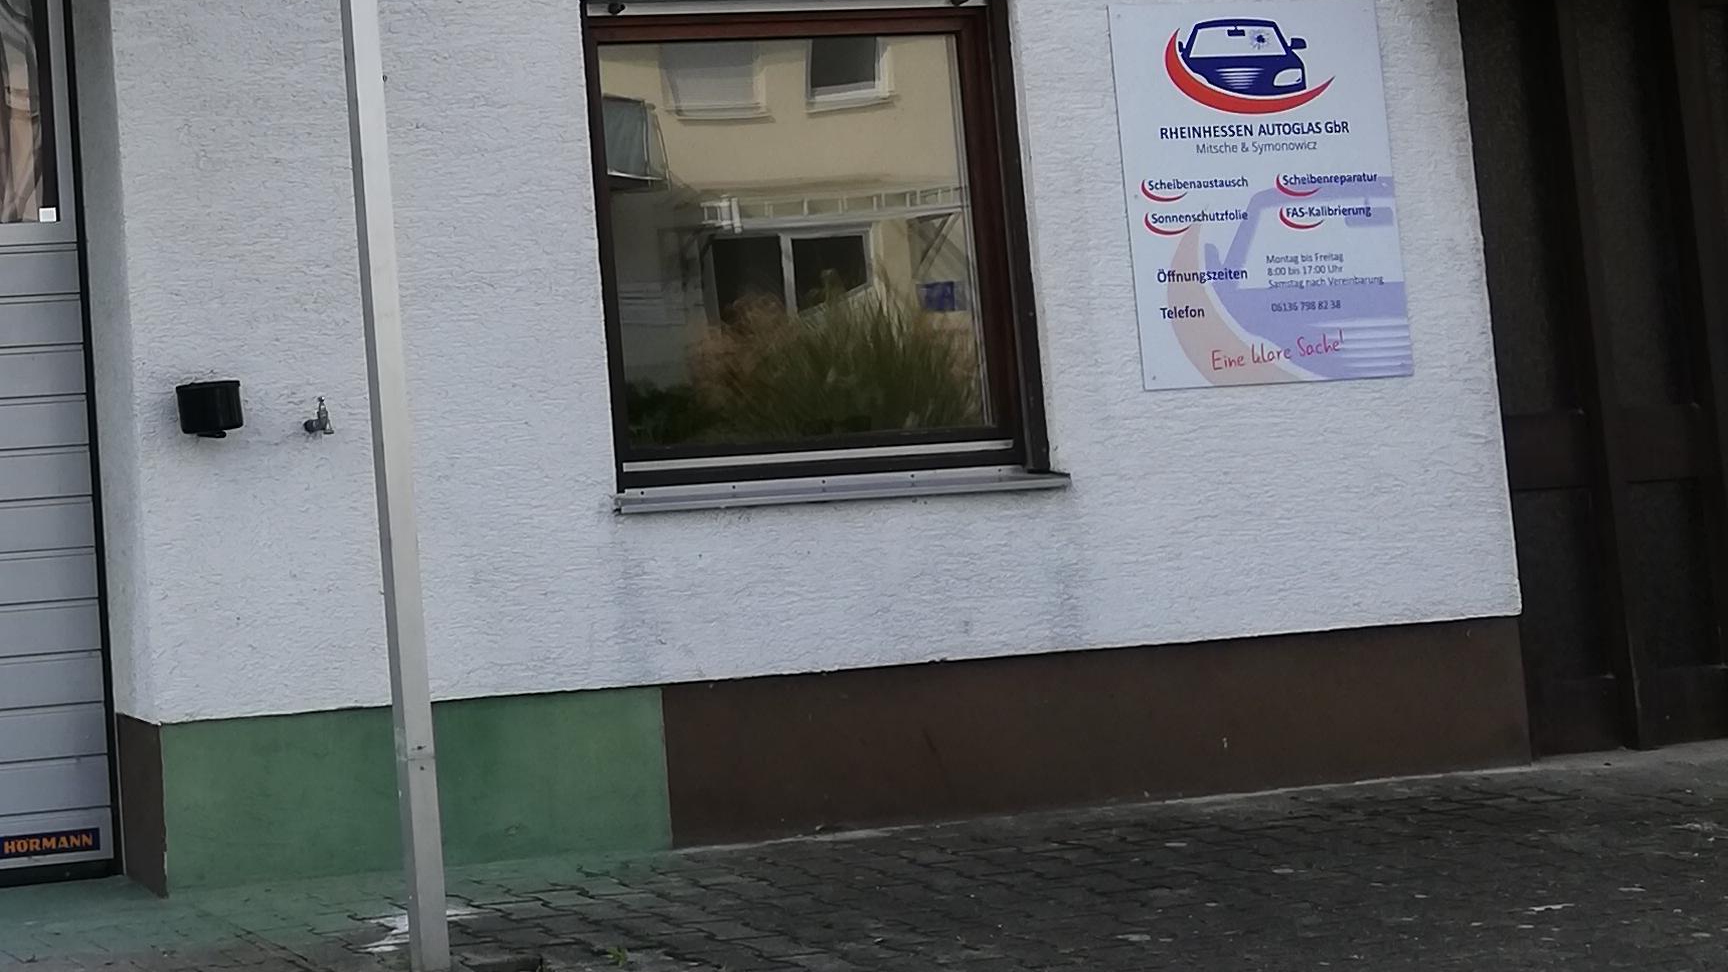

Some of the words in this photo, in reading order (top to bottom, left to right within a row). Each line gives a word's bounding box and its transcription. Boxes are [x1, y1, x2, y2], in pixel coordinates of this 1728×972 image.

[1160, 124, 1254, 140] RHEINHESSEN
[1258, 121, 1322, 136] AUTOGLAS
[1325, 119, 1350, 134] GbR
[1196, 142, 1238, 154] Mitsche
[1240, 141, 1250, 153] &
[1252, 140, 1318, 155] Symonowicz
[1148, 176, 1249, 191] Scheibenaustausch
[1282, 172, 1378, 186] Scheibenreparatur
[1151, 209, 1249, 224] Sonnenschutzfolie
[1286, 205, 1372, 218] FAS-Kalibrierung
[1266, 254, 1299, 265] Montag
[1301, 253, 1313, 263] bis
[1315, 252, 1344, 263] Freitag
[1157, 268, 1248, 283] Öffnungszeiten
[1328, 264, 1343, 274] Uhr
[1160, 306, 1205, 319] Telefon
[1211, 349, 1246, 371] Eine
[1251, 343, 1292, 365] klare
[1297, 329, 1345, 357] Sache!
